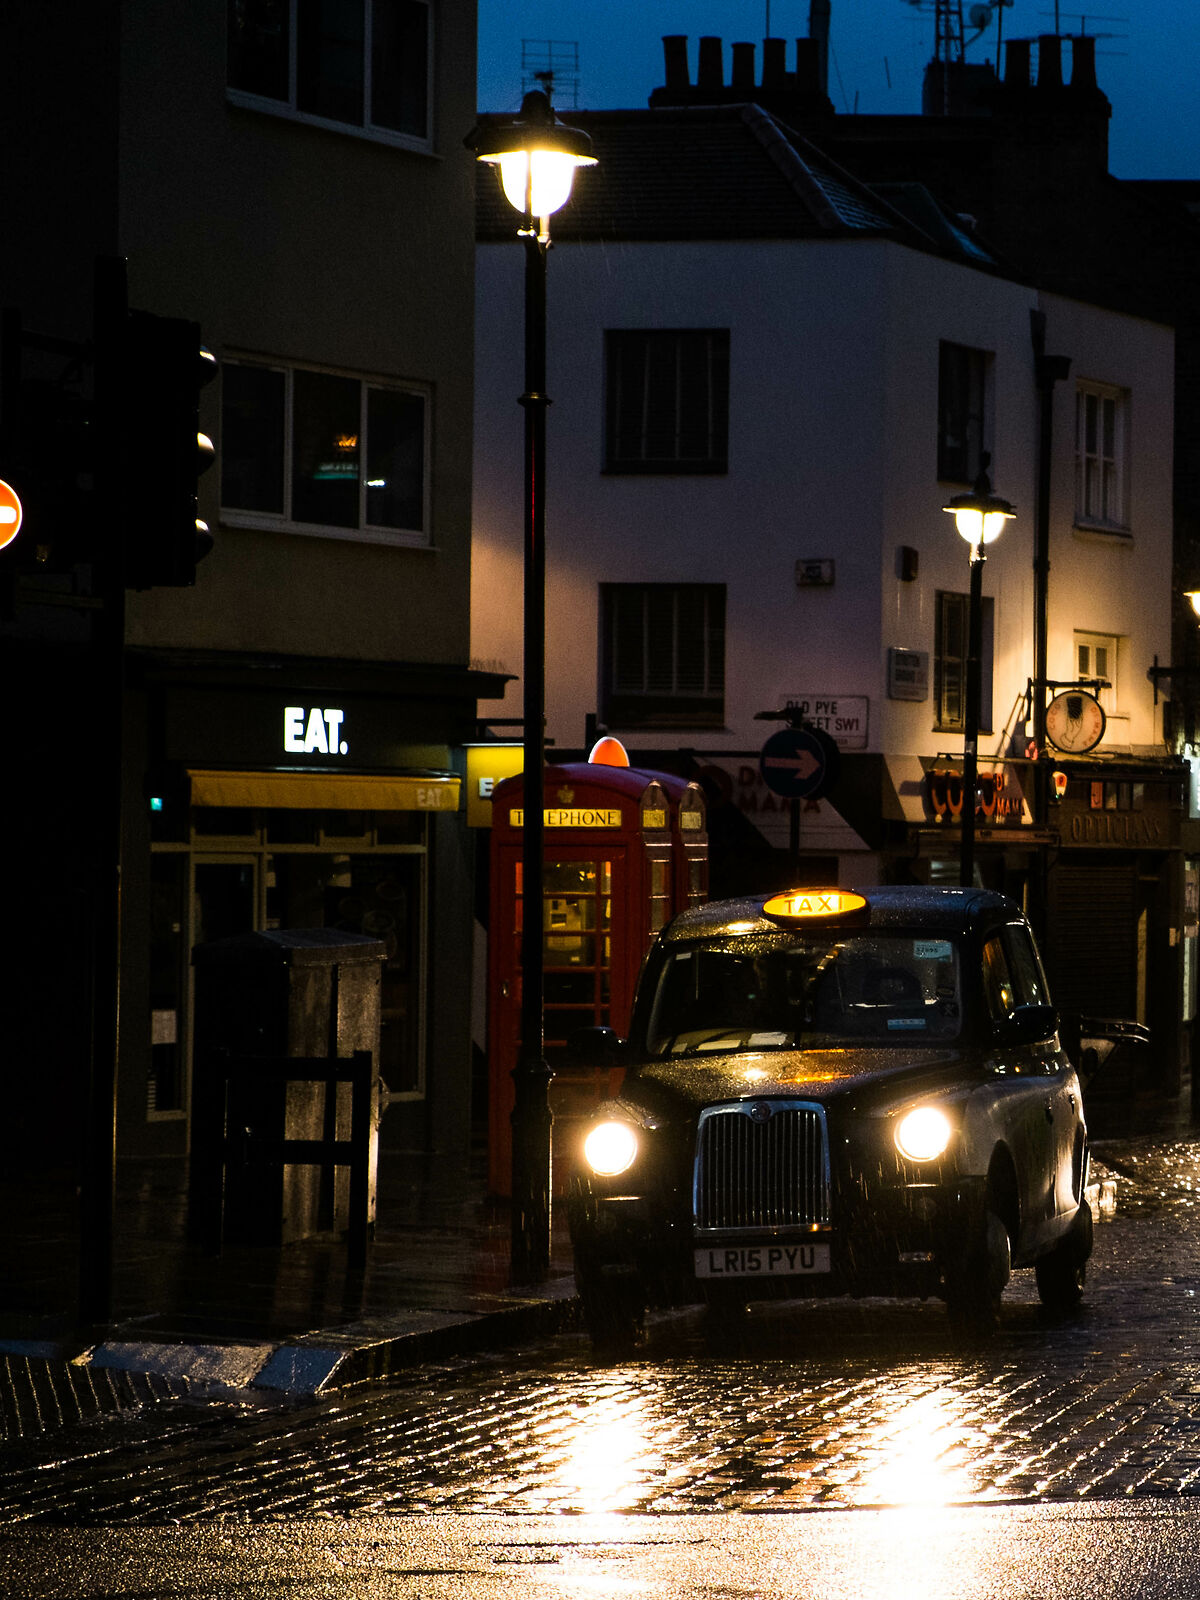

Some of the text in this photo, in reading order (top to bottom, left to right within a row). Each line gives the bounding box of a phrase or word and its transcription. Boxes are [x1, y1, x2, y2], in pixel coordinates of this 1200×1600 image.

[815, 701, 838, 714] PYE
[284, 706, 349, 755] EAT.
[835, 718, 860, 731] SW1
[926, 769, 997, 816] COO
[517, 812, 616, 826] TEPHONE
[1071, 815, 1161, 842] OPTICIANS
[783, 895, 843, 914] TAXI
[709, 1247, 815, 1272] LR15 PYU
